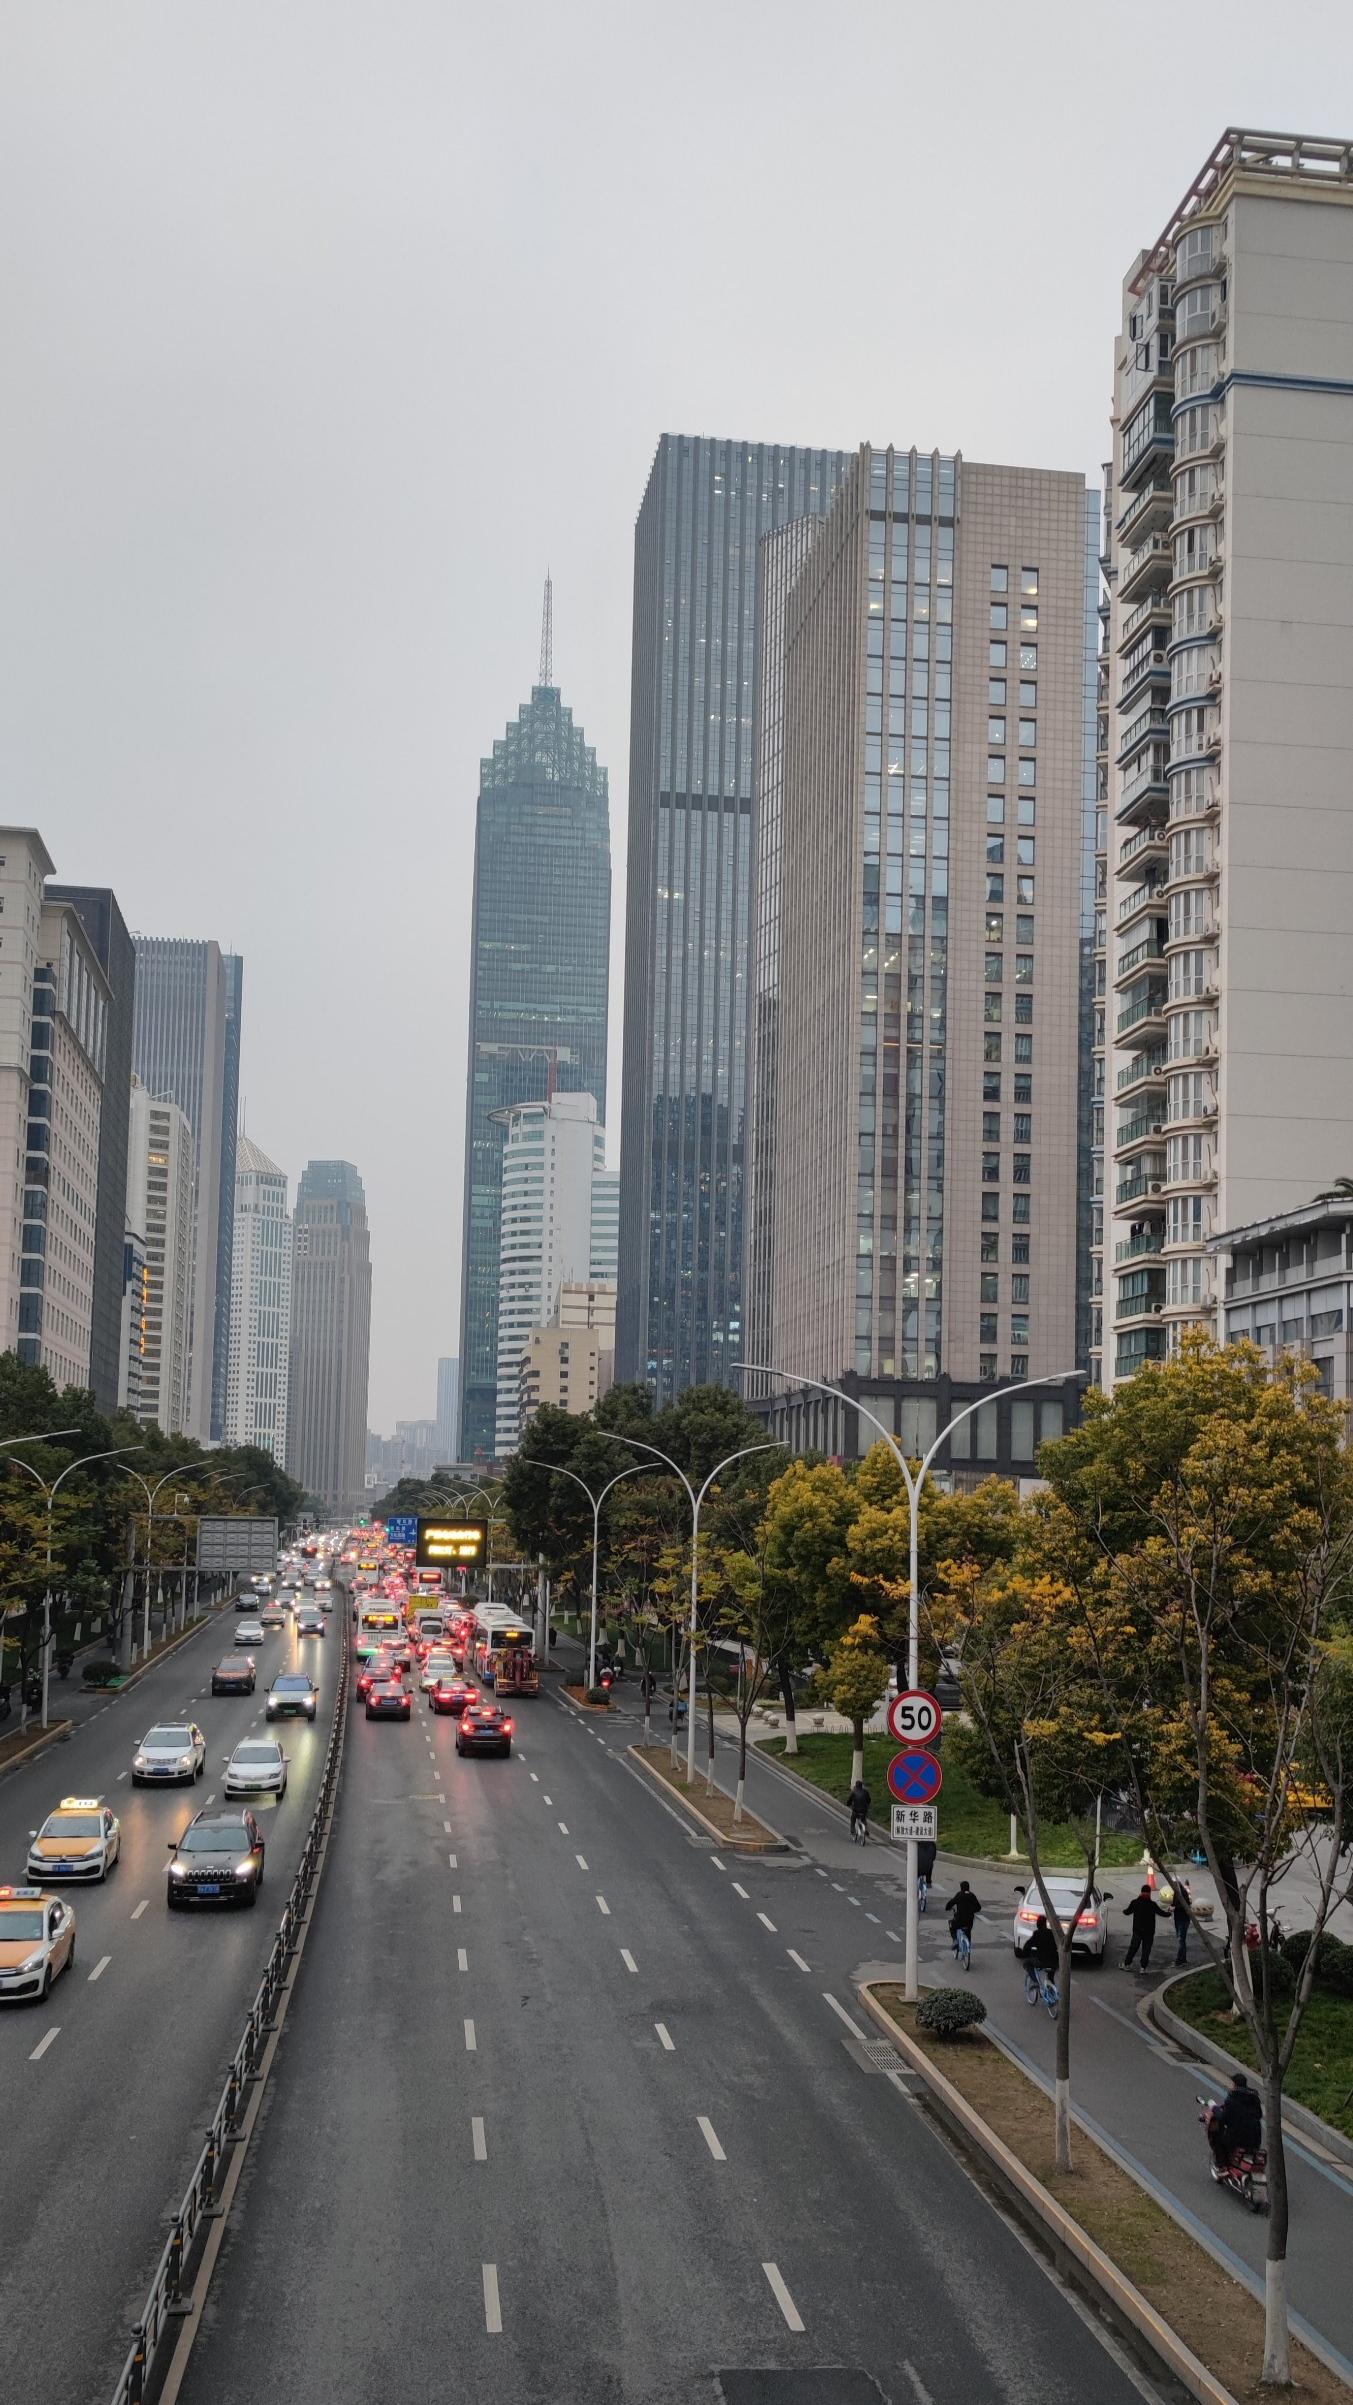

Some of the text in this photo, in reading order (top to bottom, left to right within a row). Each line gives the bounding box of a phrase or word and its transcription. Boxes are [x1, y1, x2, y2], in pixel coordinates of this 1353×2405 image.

[901, 1705, 932, 1731] 50
[896, 1809, 933, 1823] 新华路
